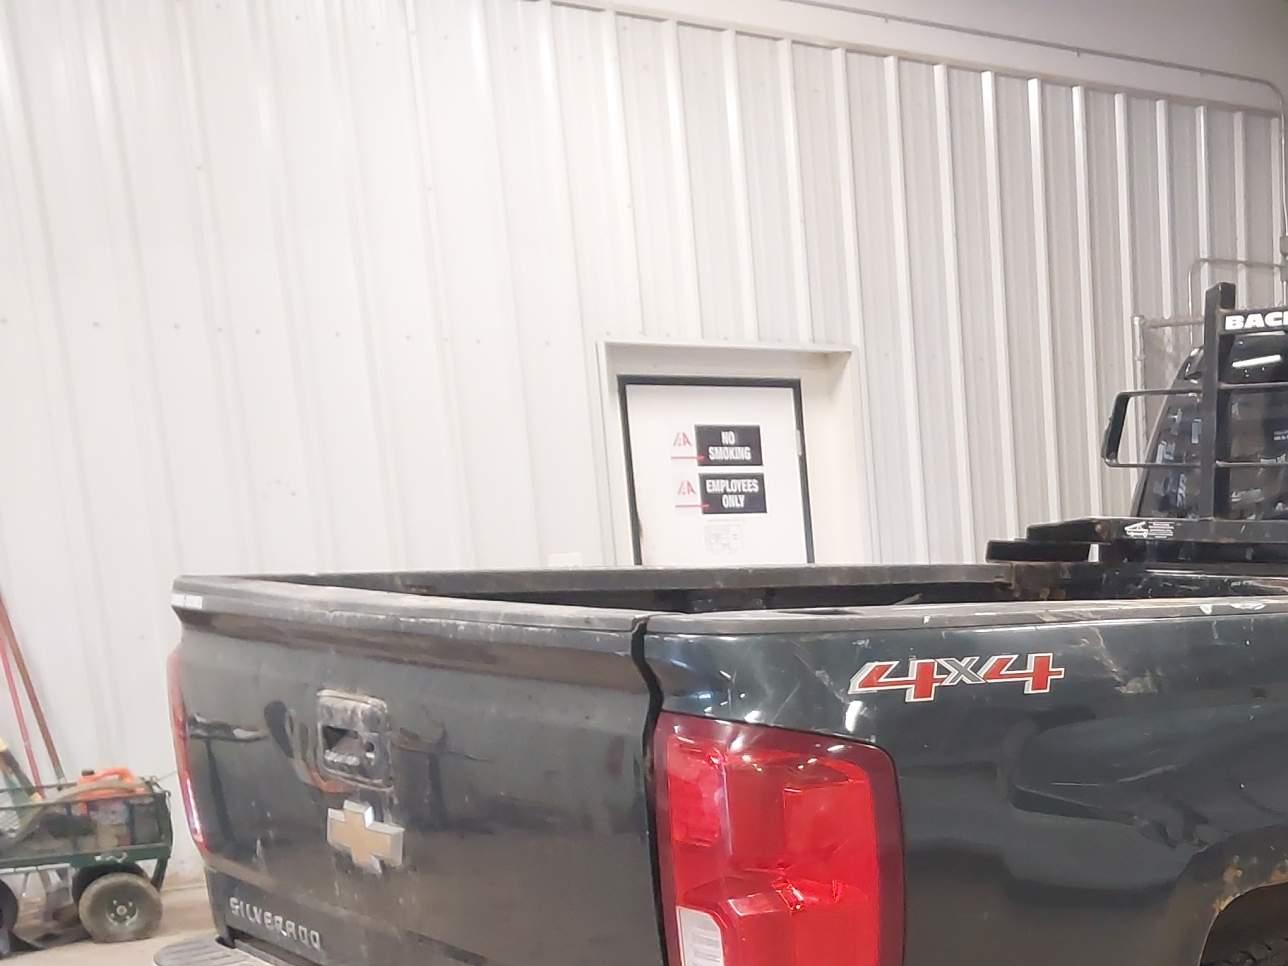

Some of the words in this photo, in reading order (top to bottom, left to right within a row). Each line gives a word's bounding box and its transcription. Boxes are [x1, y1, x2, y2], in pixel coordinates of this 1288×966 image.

[721, 431, 735, 445] NO
[708, 447, 751, 460] SMOKING
[705, 479, 759, 493] EMPLOYEES
[722, 495, 745, 508] ONLY
[229, 897, 322, 951] SILVERADO
